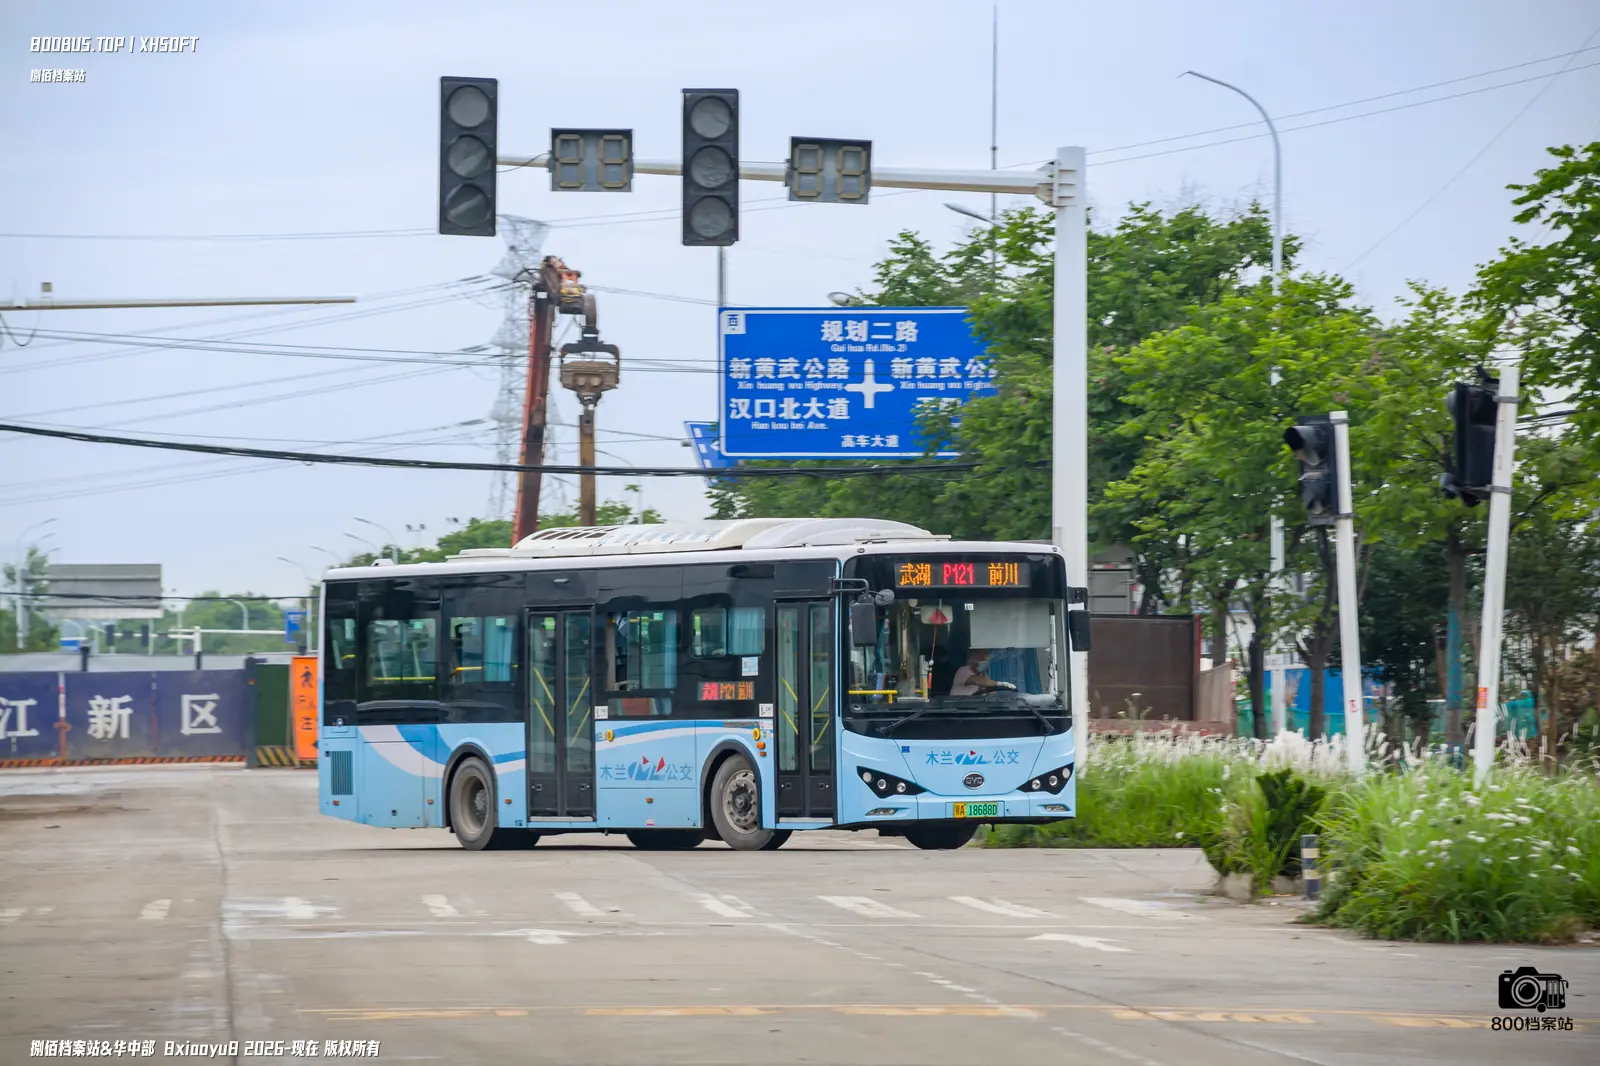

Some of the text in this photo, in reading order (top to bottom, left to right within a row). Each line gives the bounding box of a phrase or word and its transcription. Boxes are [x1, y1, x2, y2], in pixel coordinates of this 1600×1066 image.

[820, 320, 919, 343] 规划二路
[728, 356, 850, 380] 新黄武公路
[728, 397, 851, 420] 汉口北大道
[841, 434, 900, 448] 高车大道
[899, 562, 1019, 586] 武湖 P121 前川
[925, 750, 954, 767] 木兰
[993, 749, 1020, 765] 公交
[599, 763, 627, 781] 木兰
[665, 763, 693, 781] 公交
